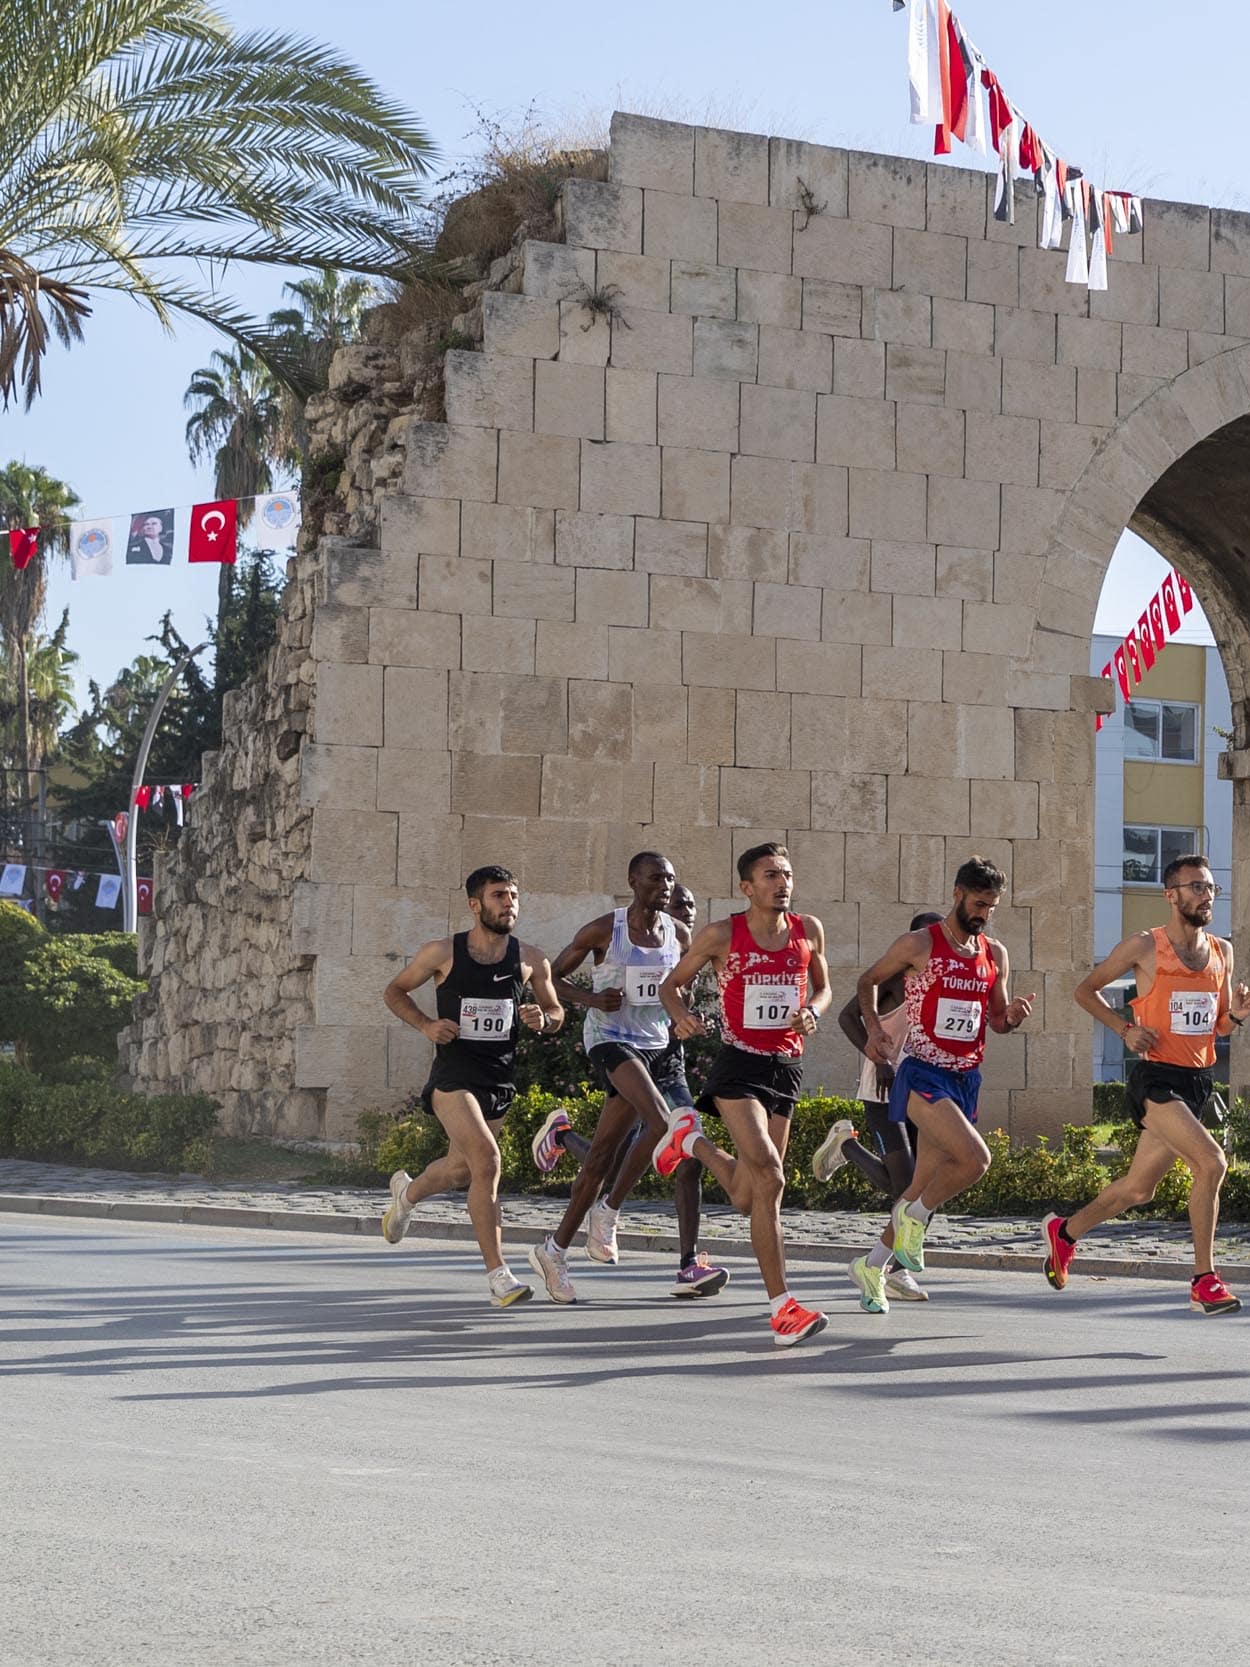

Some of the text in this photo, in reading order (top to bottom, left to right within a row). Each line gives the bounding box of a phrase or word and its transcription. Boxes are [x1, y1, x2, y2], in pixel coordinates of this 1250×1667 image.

[636, 983, 657, 997] 10
[942, 975, 988, 993] TÜRKİYE
[756, 1005, 790, 1020] 107
[1170, 1001, 1183, 1011] 104
[472, 1017, 504, 1032] 190
[944, 1017, 974, 1033] 279
[1183, 1011, 1209, 1026] 104
